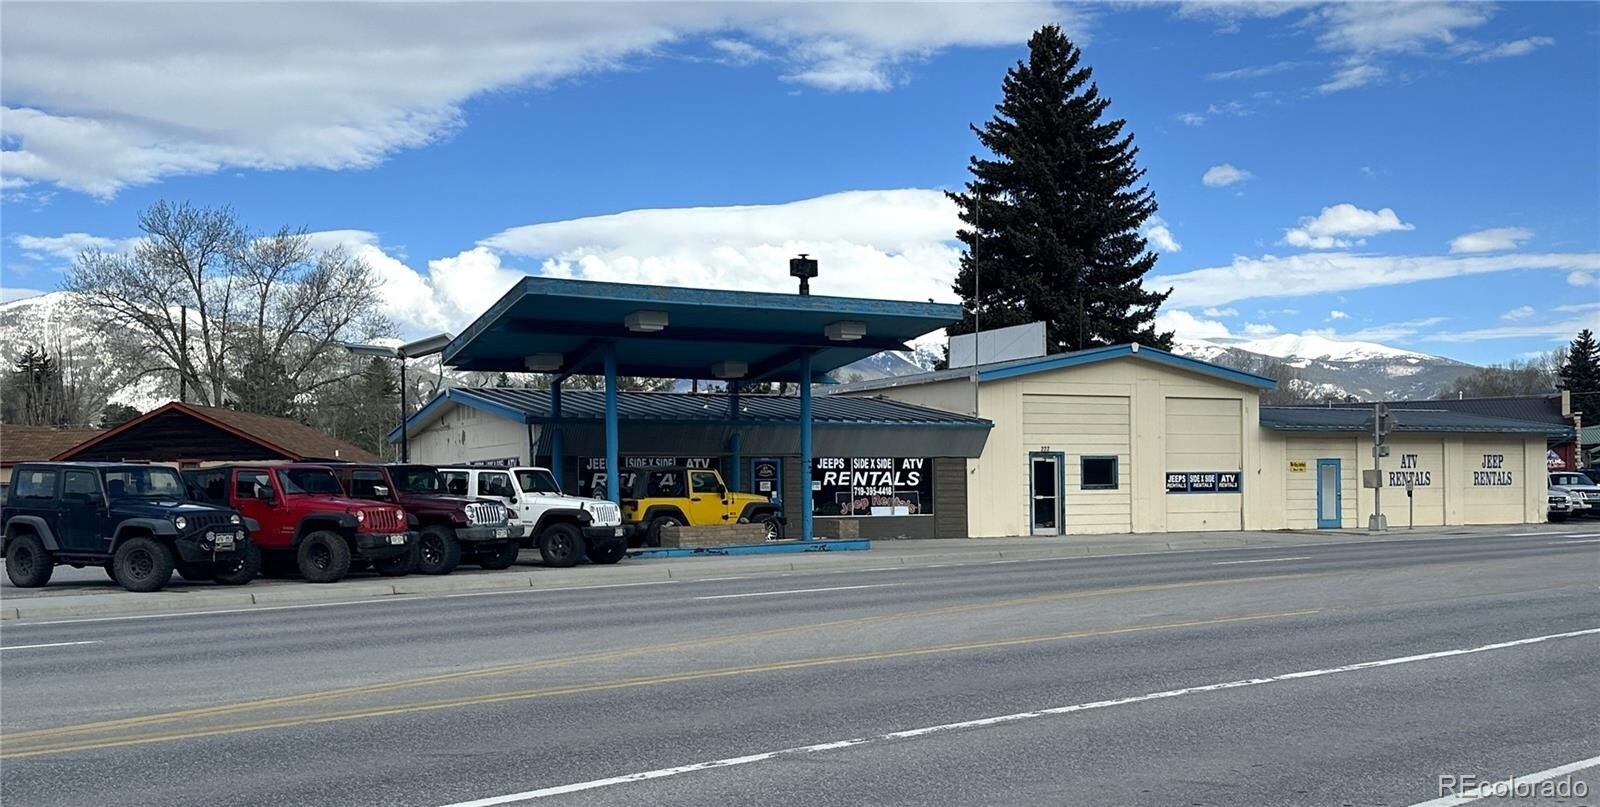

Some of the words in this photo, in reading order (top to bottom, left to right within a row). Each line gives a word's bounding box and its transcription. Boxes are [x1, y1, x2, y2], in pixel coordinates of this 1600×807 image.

[686, 458, 710, 468] ATV
[817, 458, 845, 469] JEEPS
[853, 458, 870, 469] SIDE
[870, 458, 876, 469] X
[876, 458, 892, 469] SIDE
[902, 458, 924, 469] ATV
[1400, 454, 1418, 468] ATV
[1482, 454, 1504, 468] JEEP
[824, 472, 920, 486] RENTALS
[1168, 475, 1186, 483] JEEPS
[1189, 475, 1200, 483] SIDE
[1204, 475, 1215, 483] SIDE
[1221, 475, 1235, 483] ATV
[1389, 471, 1431, 486] RENTALS
[1473, 471, 1513, 486] RENTALS
